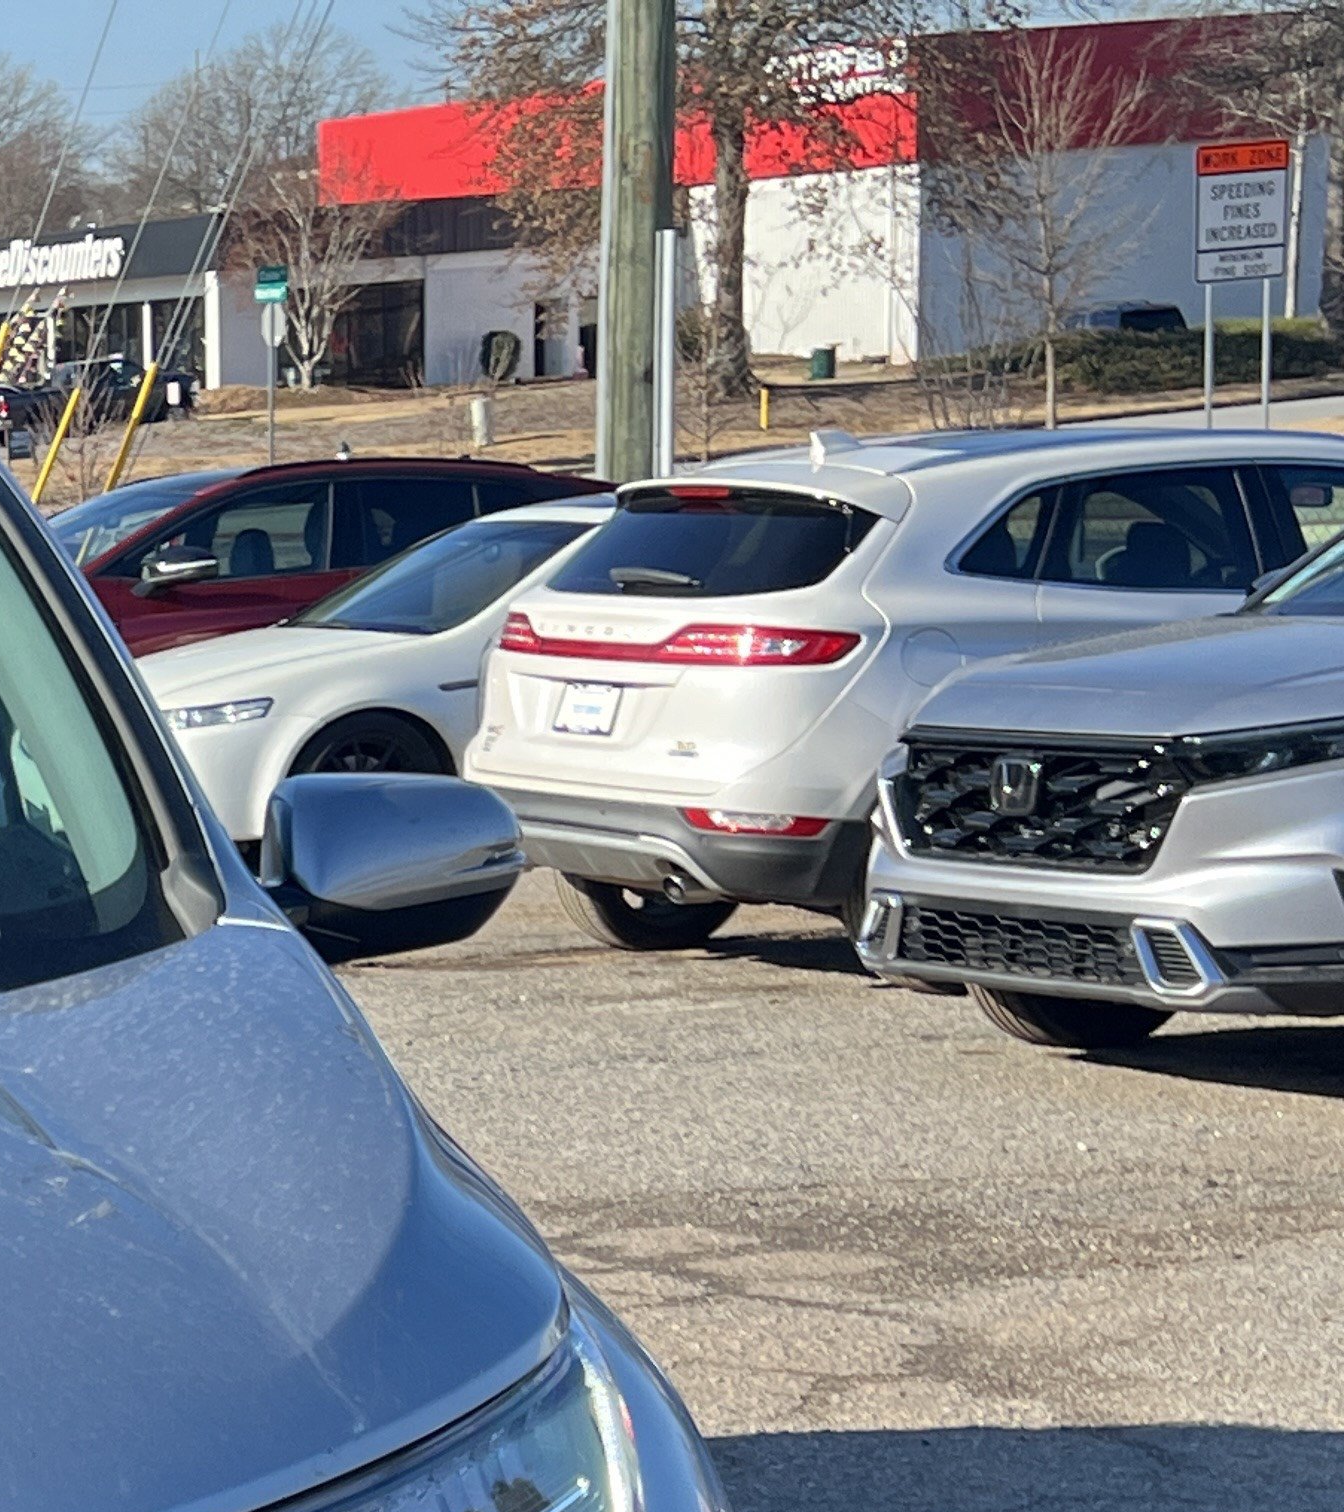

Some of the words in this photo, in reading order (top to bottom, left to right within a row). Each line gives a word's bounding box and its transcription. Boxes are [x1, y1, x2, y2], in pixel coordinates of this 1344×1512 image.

[1202, 152, 1238, 168] WORK
[1249, 148, 1283, 166] ZONE
[1210, 180, 1276, 201] SPEEDING
[1223, 202, 1261, 220] FINES
[1205, 222, 1278, 243] INCREASED
